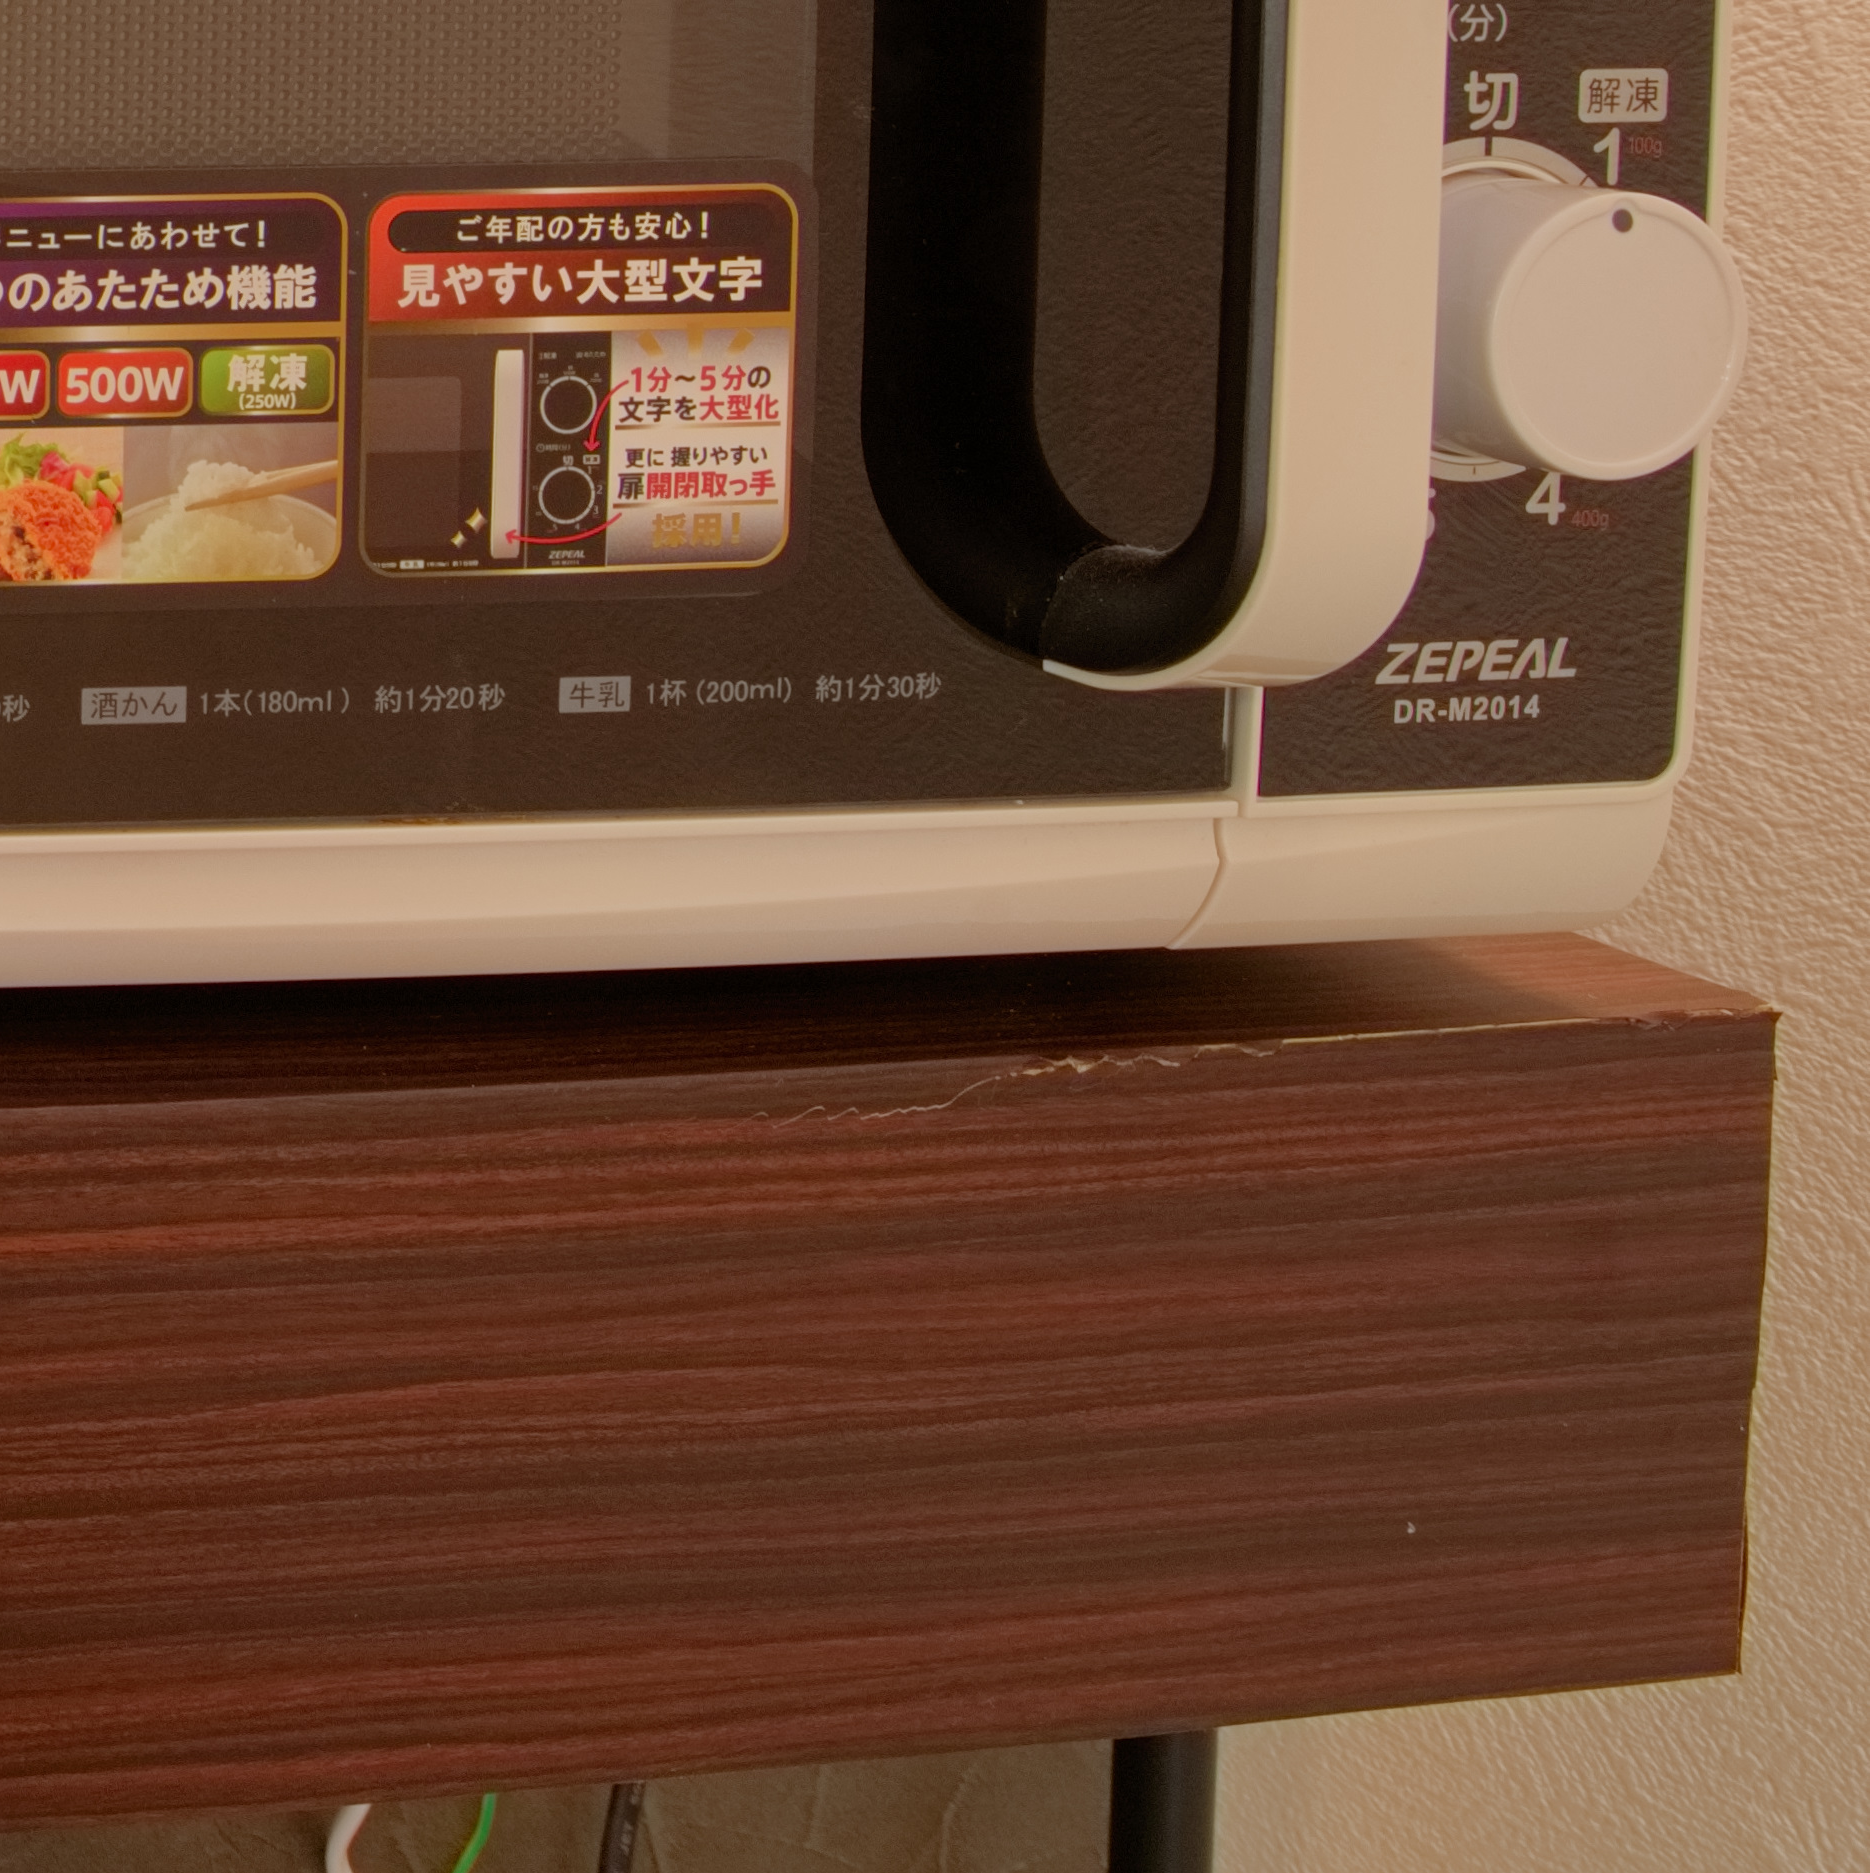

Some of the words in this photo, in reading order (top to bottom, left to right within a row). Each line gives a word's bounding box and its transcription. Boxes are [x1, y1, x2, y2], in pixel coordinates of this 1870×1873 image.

[1463, 70, 1519, 131] 切
[1586, 77, 1659, 114] 解凍
[1593, 127, 1621, 186] 1
[1628, 136, 1664, 159] 100g
[456, 211, 710, 243] ご年配の方も安心！
[398, 256, 763, 309] 見やすい大型文字
[65, 366, 184, 404] 500W
[227, 353, 308, 394] 解凍
[238, 392, 296, 411] (250W)
[618, 393, 780, 423] 文字を大型化
[671, 445, 768, 467] 握りやすい
[617, 469, 777, 500] 扉開閉取っ手
[1525, 471, 1566, 526] 4
[652, 512, 742, 549] 採用！
[1375, 637, 1578, 685] ZEPEAL
[90, 691, 179, 720] 酒かん
[374, 682, 507, 714] 約1分20秒
[568, 680, 625, 708] 牛乳
[815, 671, 942, 704] 約1分30秒
[1393, 694, 1540, 724] DR-M2014
